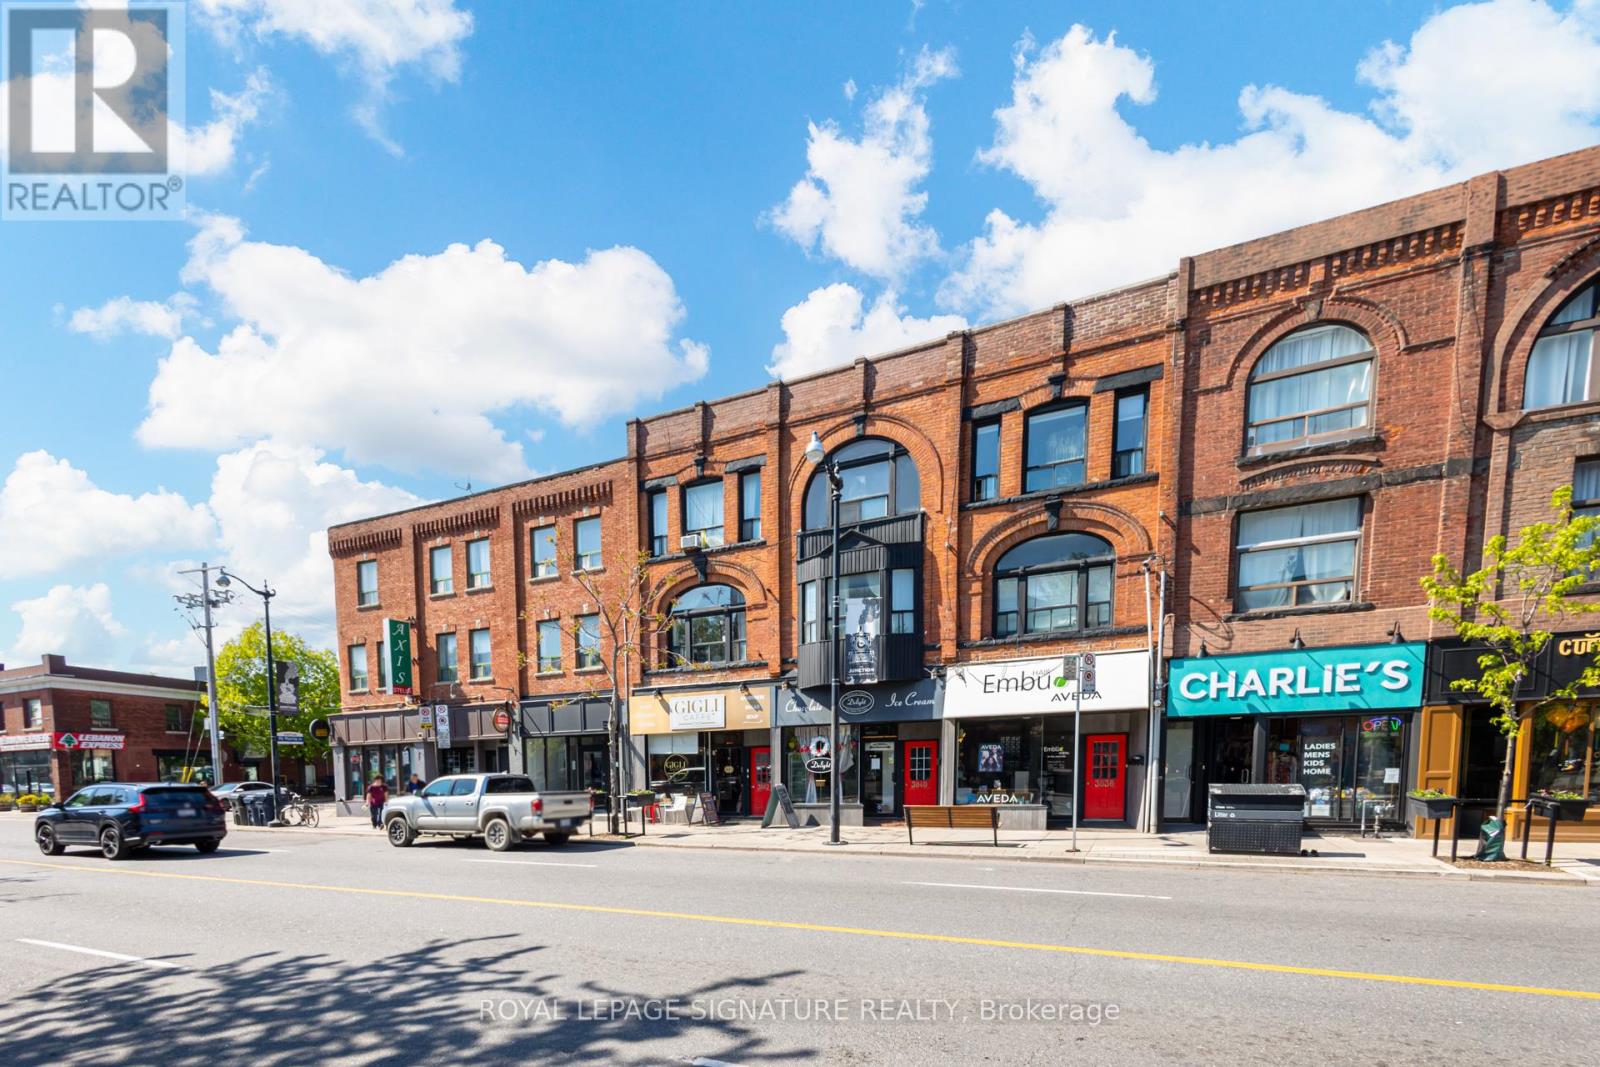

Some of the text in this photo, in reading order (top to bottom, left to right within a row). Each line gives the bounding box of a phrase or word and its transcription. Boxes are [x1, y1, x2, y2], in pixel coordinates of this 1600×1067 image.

[392, 624, 407, 684] AXIS
[885, 692, 935, 707] Ice Cream
[1051, 691, 1102, 702] AVEDA
[674, 699, 719, 713] GIGLI
[665, 760, 686, 769] GIGLI
[976, 793, 1019, 804] AVEDA
